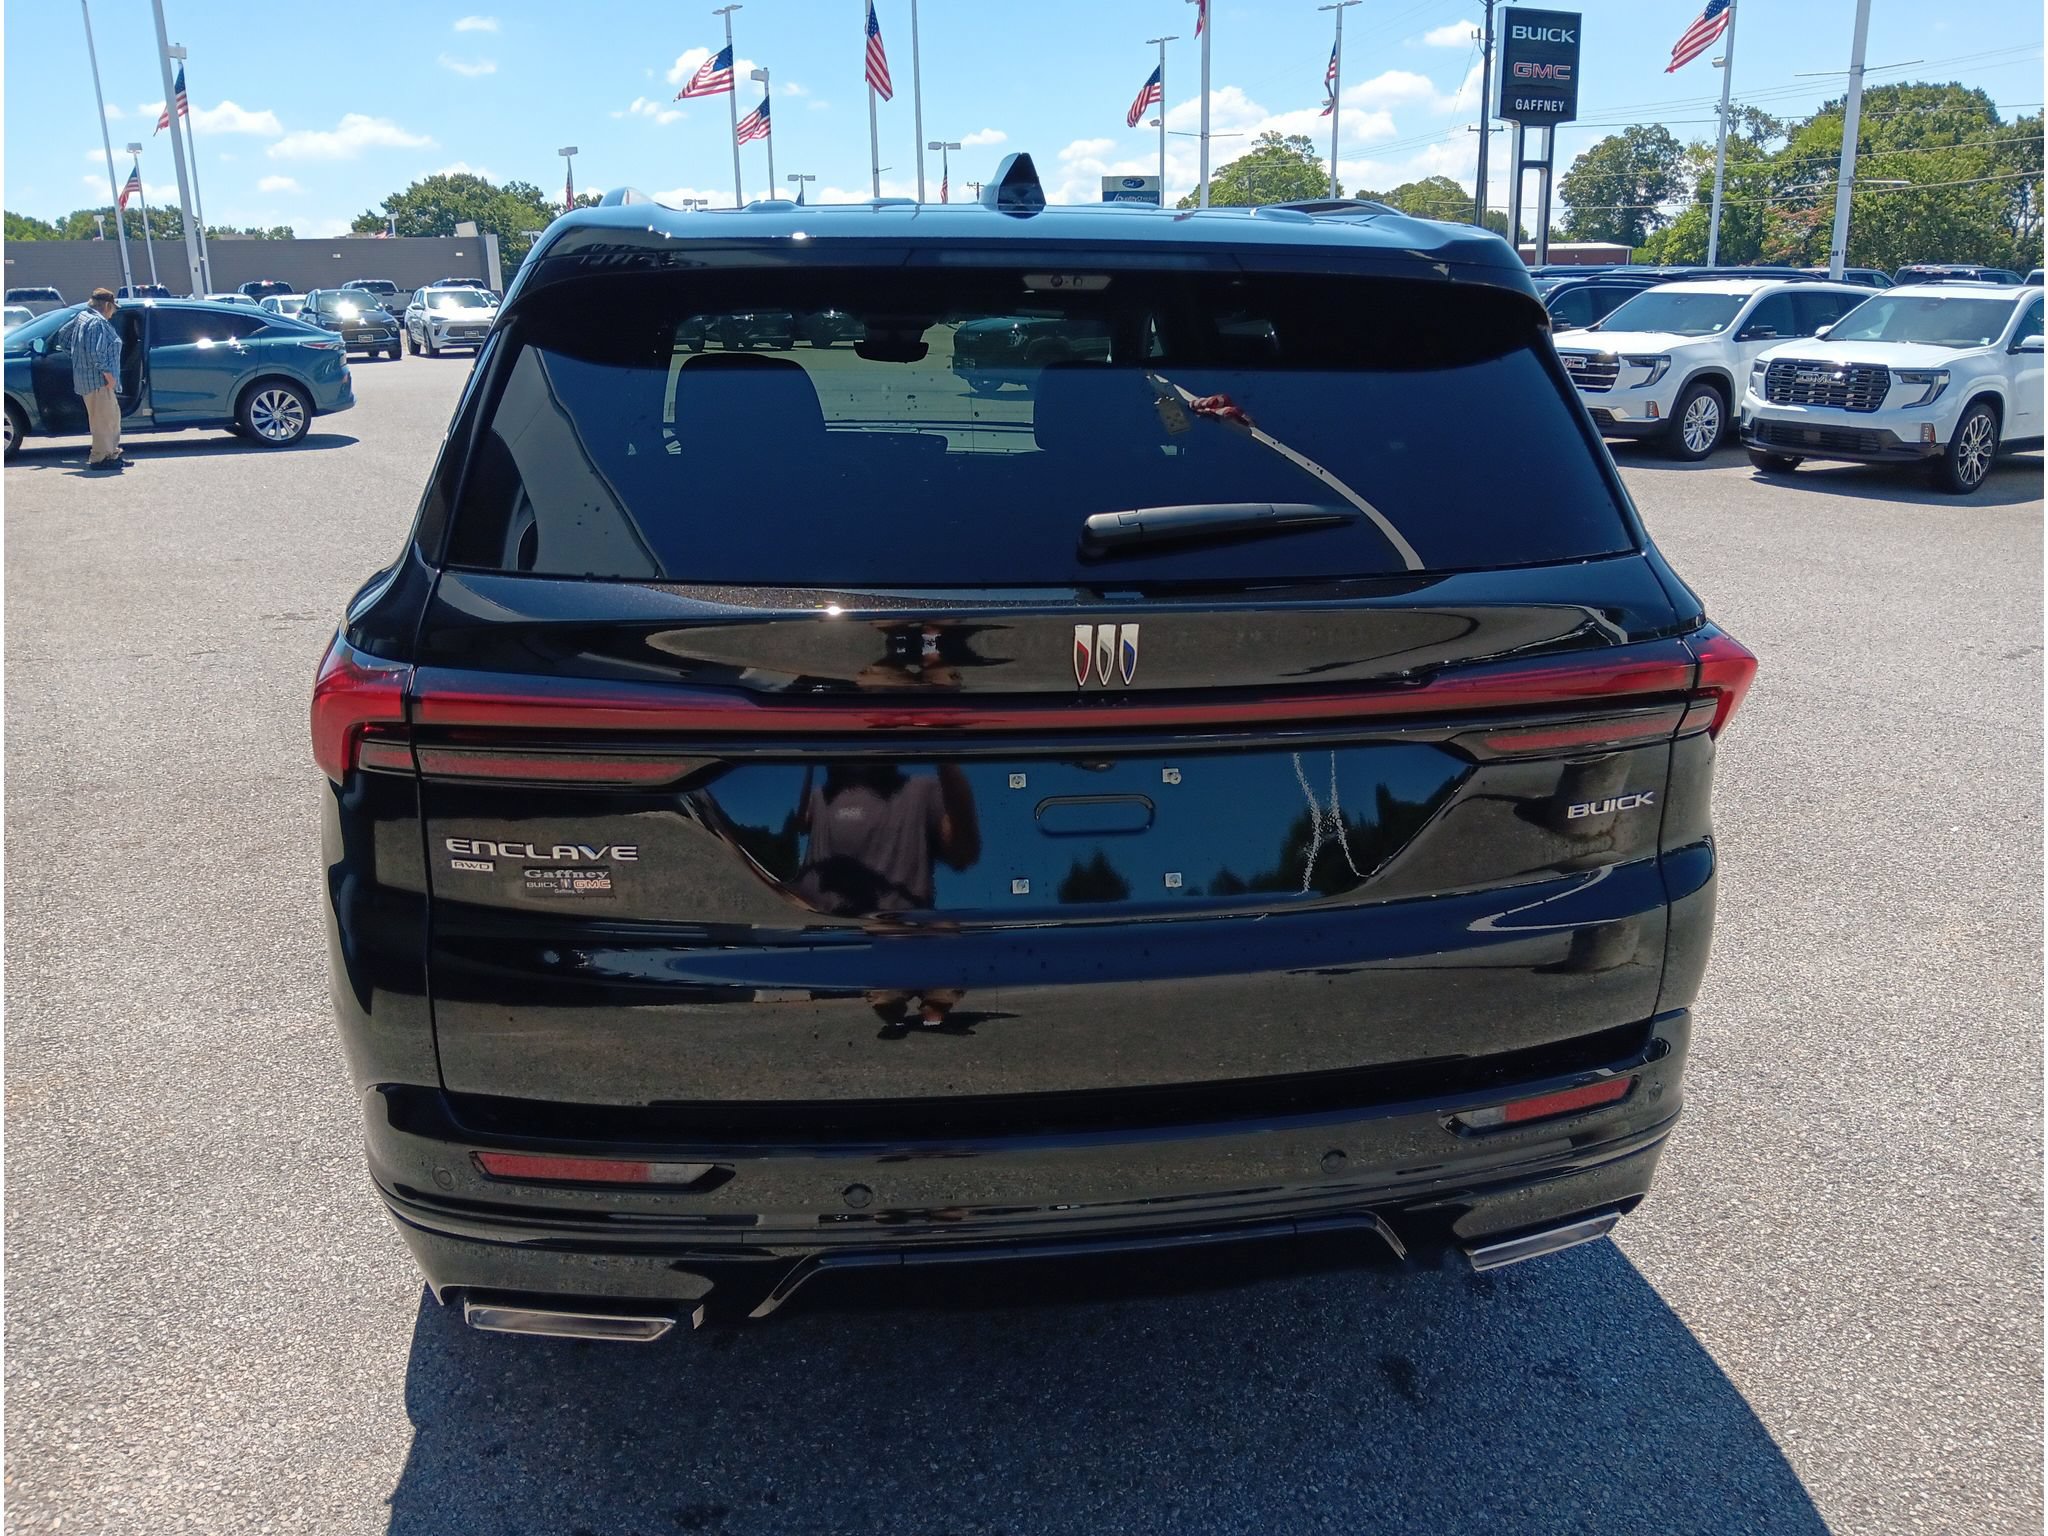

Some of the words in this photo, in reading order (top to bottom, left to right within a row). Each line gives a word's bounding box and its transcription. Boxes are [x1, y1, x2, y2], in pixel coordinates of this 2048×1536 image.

[1512, 25, 1575, 43] BUICK
[1513, 62, 1571, 80] GMC
[1515, 98, 1564, 112] GAFFNEY
[1567, 791, 1654, 819] BUICK
[445, 838, 639, 861] ENCLAVE
[454, 861, 490, 870] AWD
[524, 869, 609, 879] Gaffney
[573, 879, 611, 889] GMC
